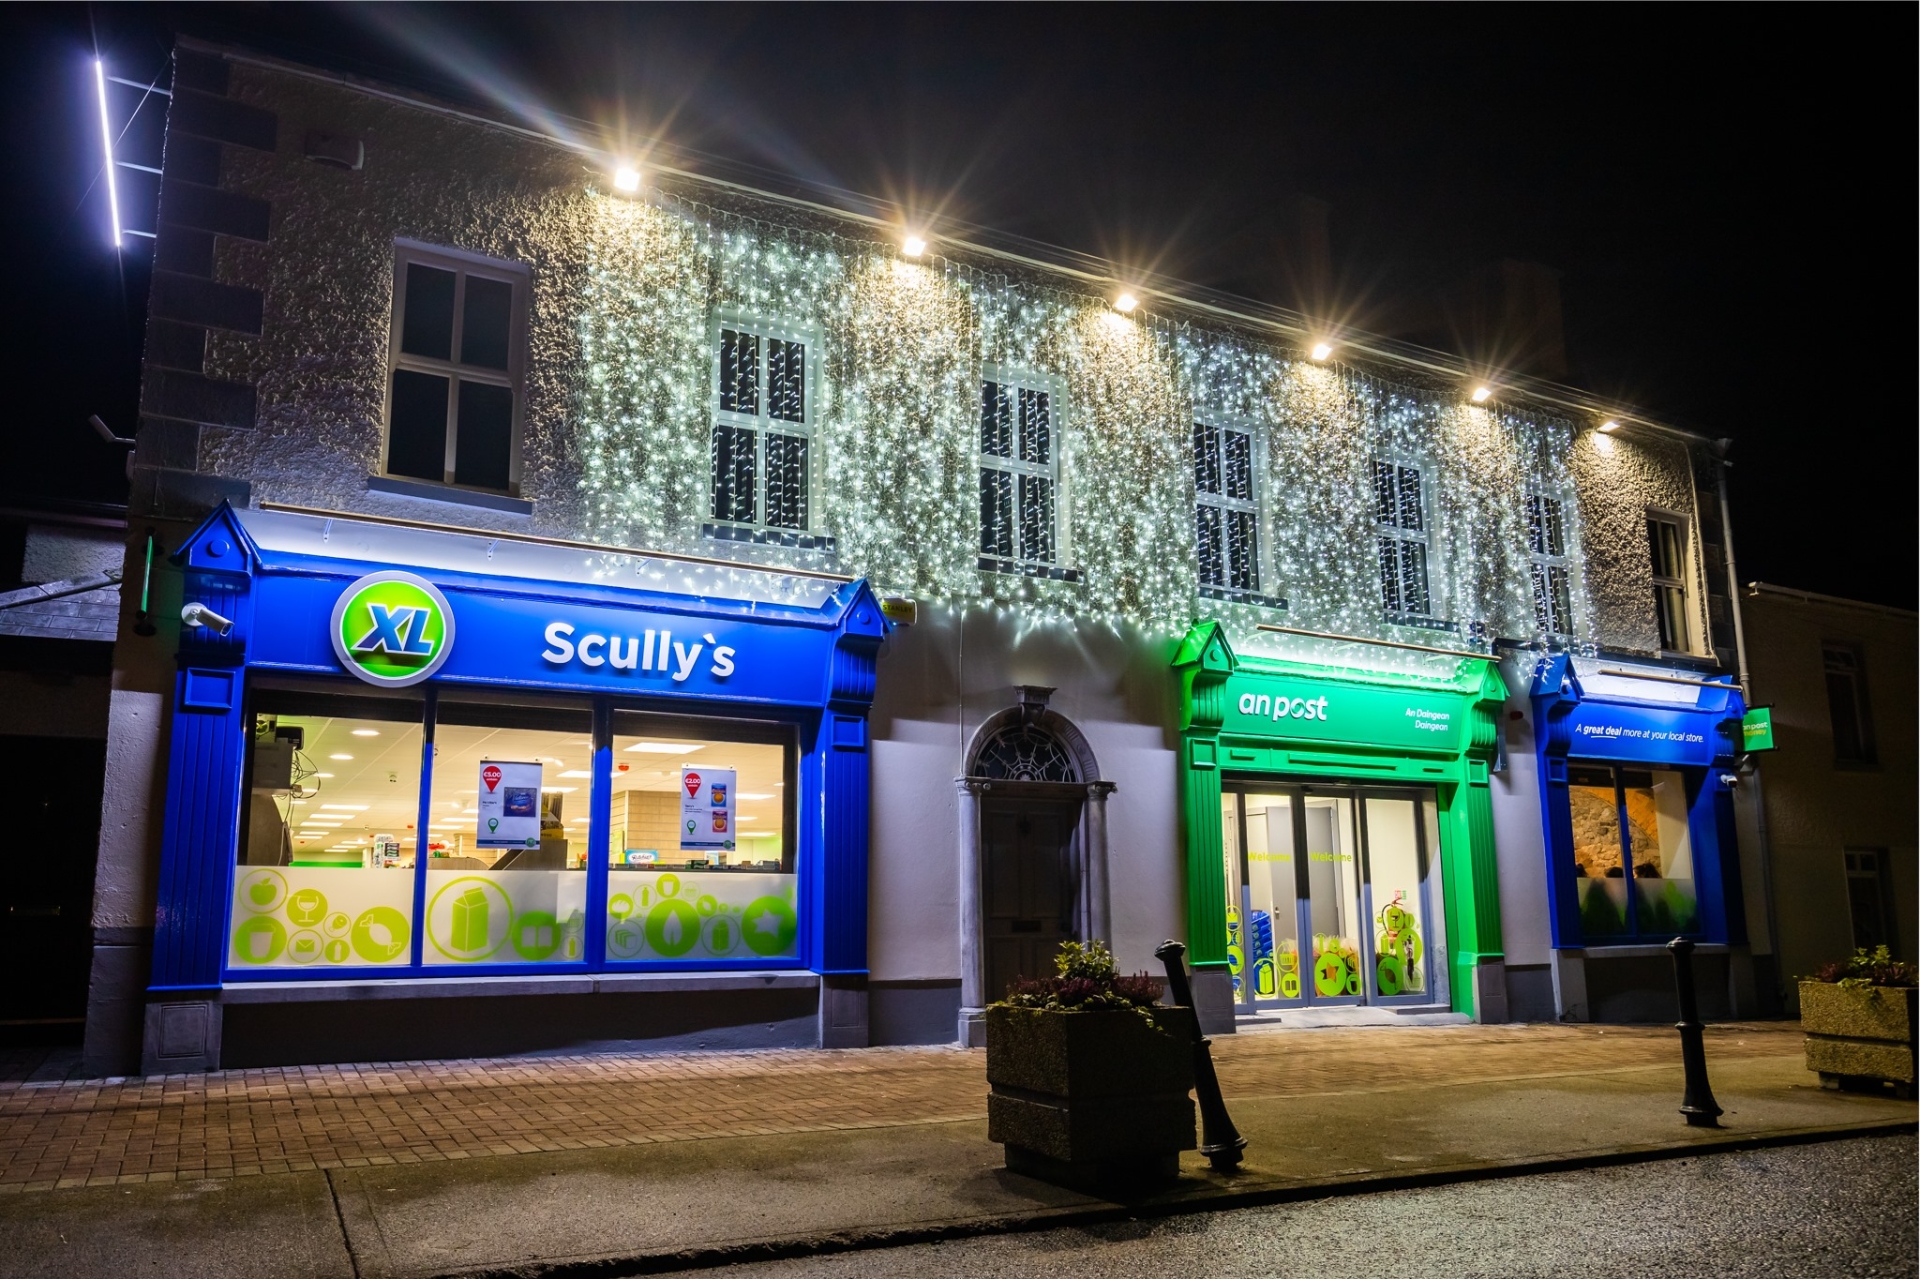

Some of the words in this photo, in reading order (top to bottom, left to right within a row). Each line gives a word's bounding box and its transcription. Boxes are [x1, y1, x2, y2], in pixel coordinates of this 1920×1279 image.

[350, 602, 436, 656] XL
[1238, 692, 1270, 716] an
[1272, 695, 1329, 721] post
[1405, 707, 1416, 717] An
[1416, 708, 1450, 721] Daingean
[1415, 720, 1449, 731] Daingean
[1575, 723, 1582, 733] A
[1583, 724, 1605, 736] great
[1605, 726, 1622, 736] deal
[1622, 729, 1642, 738] more
[1642, 729, 1650, 739] at
[1650, 731, 1668, 741] your
[1668, 731, 1685, 741] local
[1685, 733, 1704, 743] store.
[1247, 852, 1291, 862] Welcome
[1310, 852, 1352, 862] Welcome
